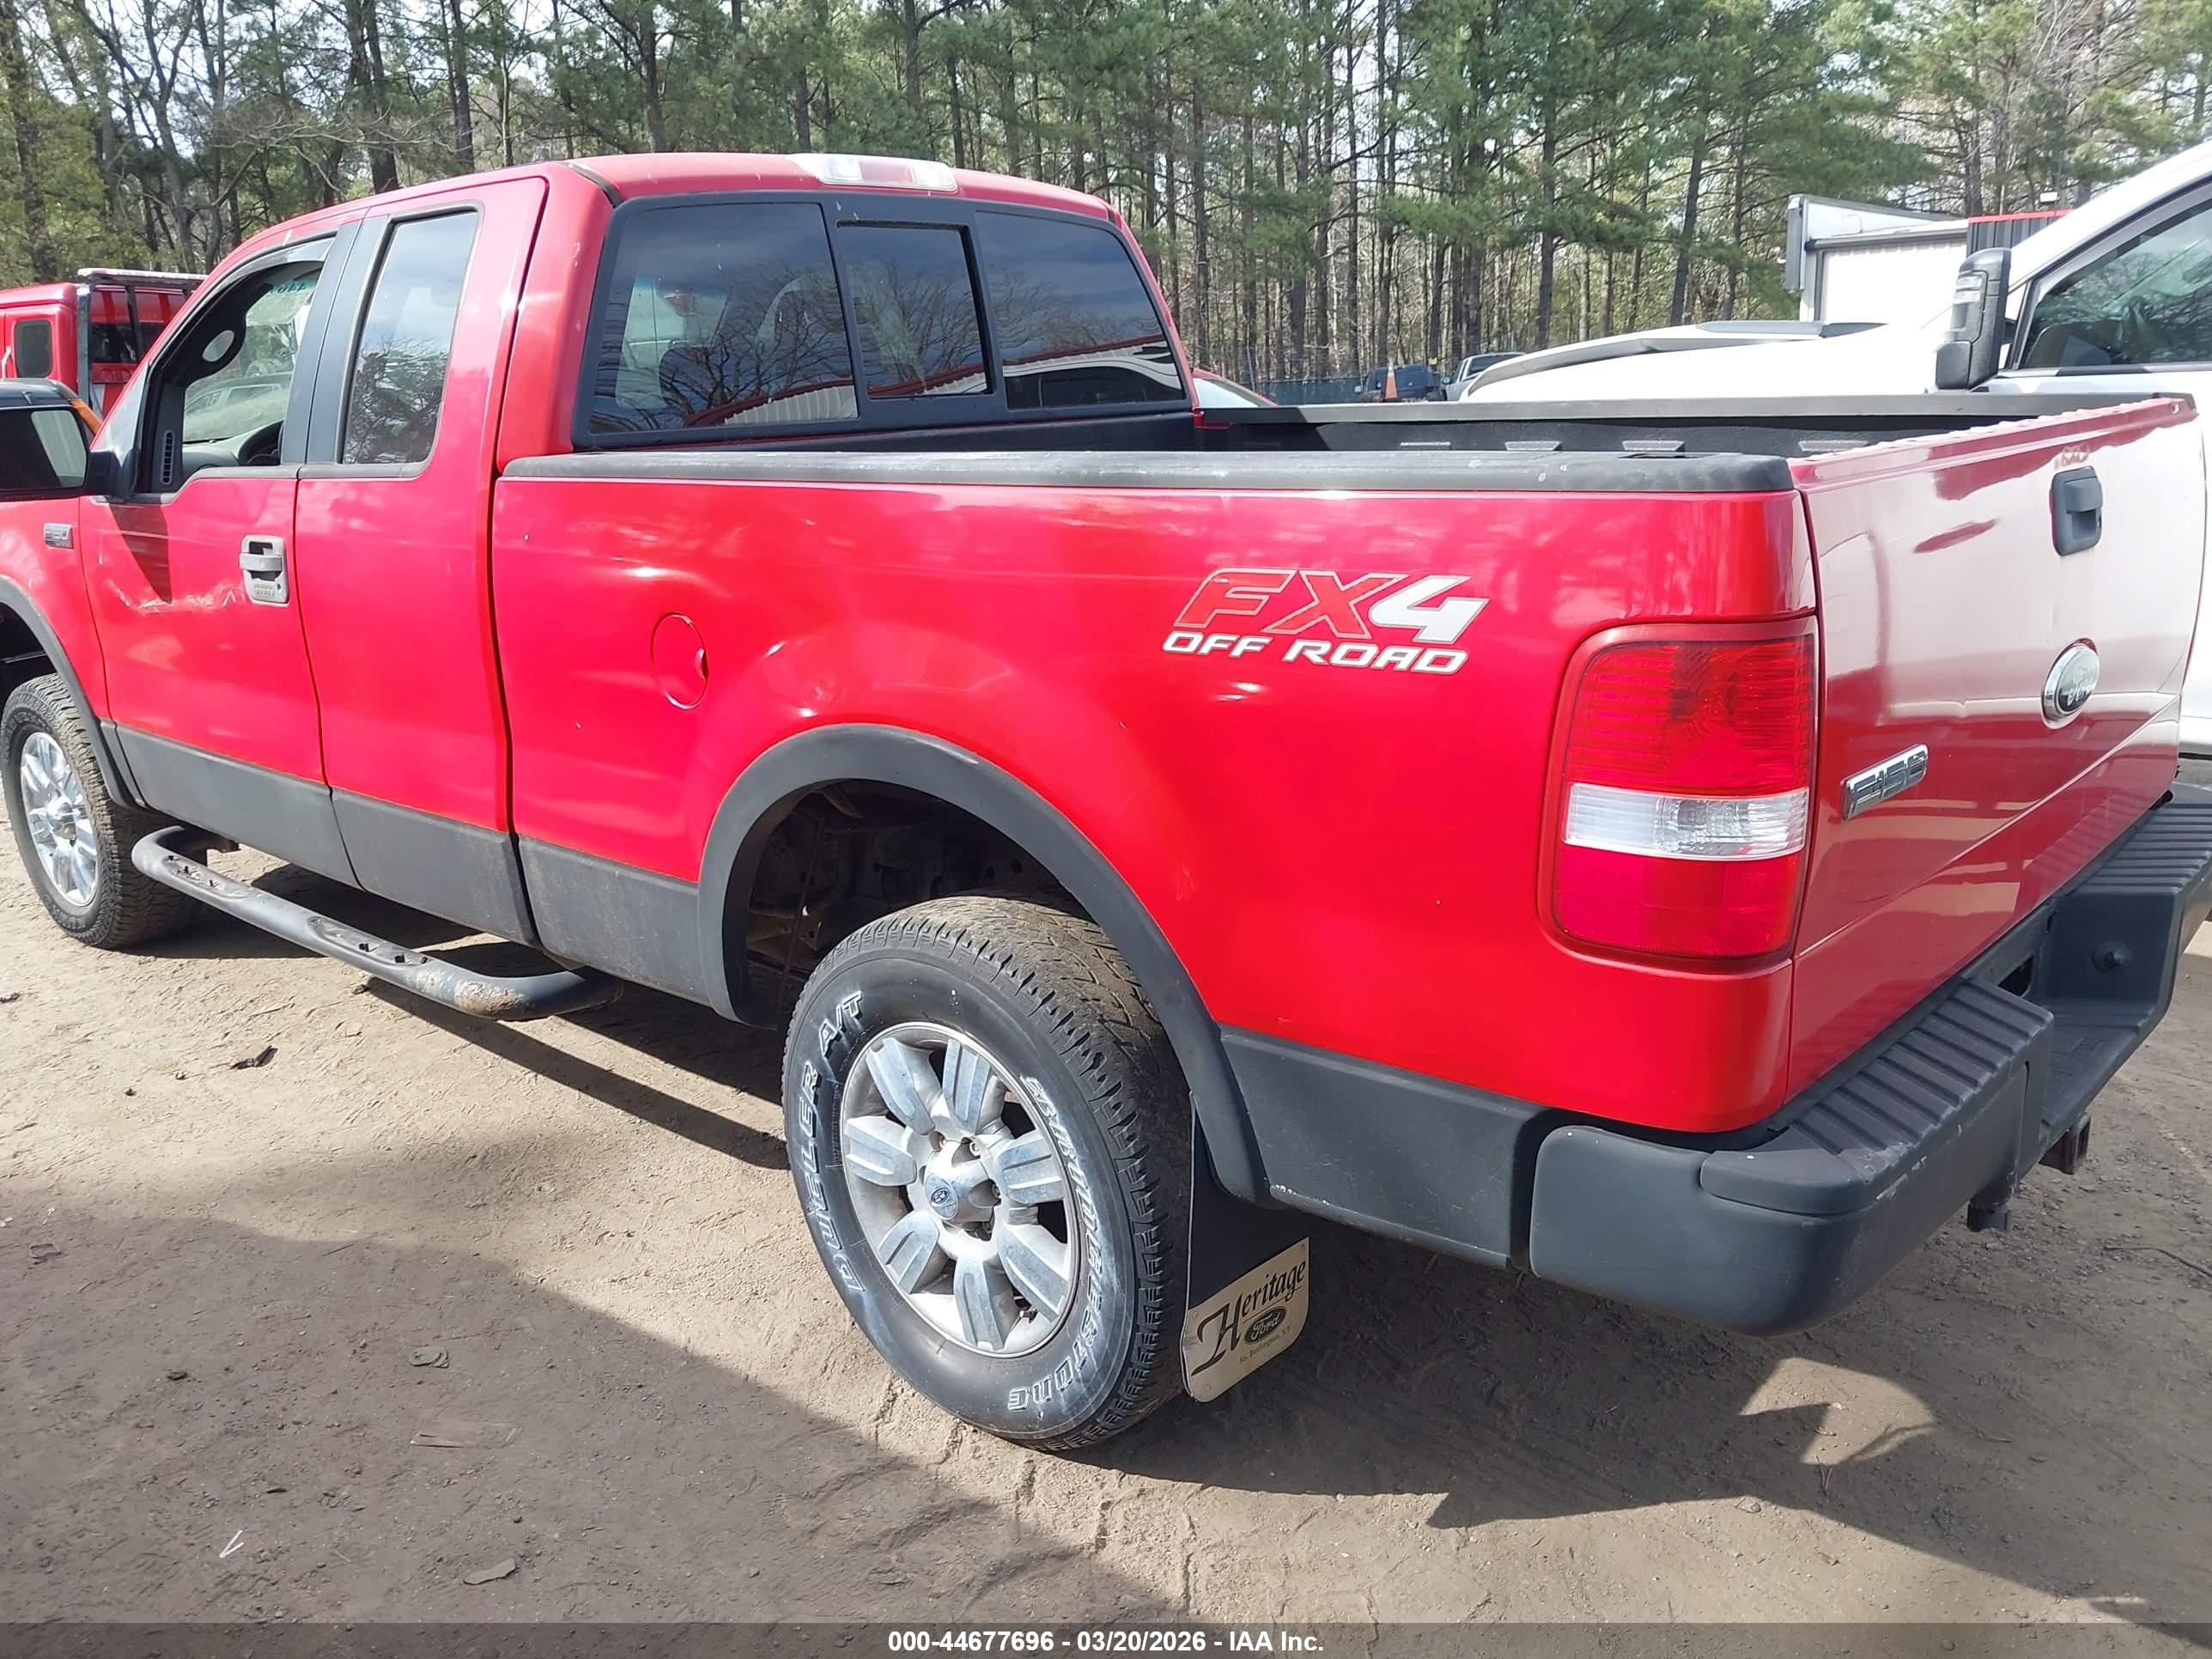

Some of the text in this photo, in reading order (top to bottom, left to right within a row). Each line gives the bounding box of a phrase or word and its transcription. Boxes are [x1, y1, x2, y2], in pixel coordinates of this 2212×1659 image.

[1173, 568, 1490, 644] FX4
[1162, 631, 1469, 674] OFF ROAD
[818, 990, 862, 1058] A/T
[1190, 1260, 1306, 1376] Heritage
[1250, 1311, 1281, 1340] Ford
